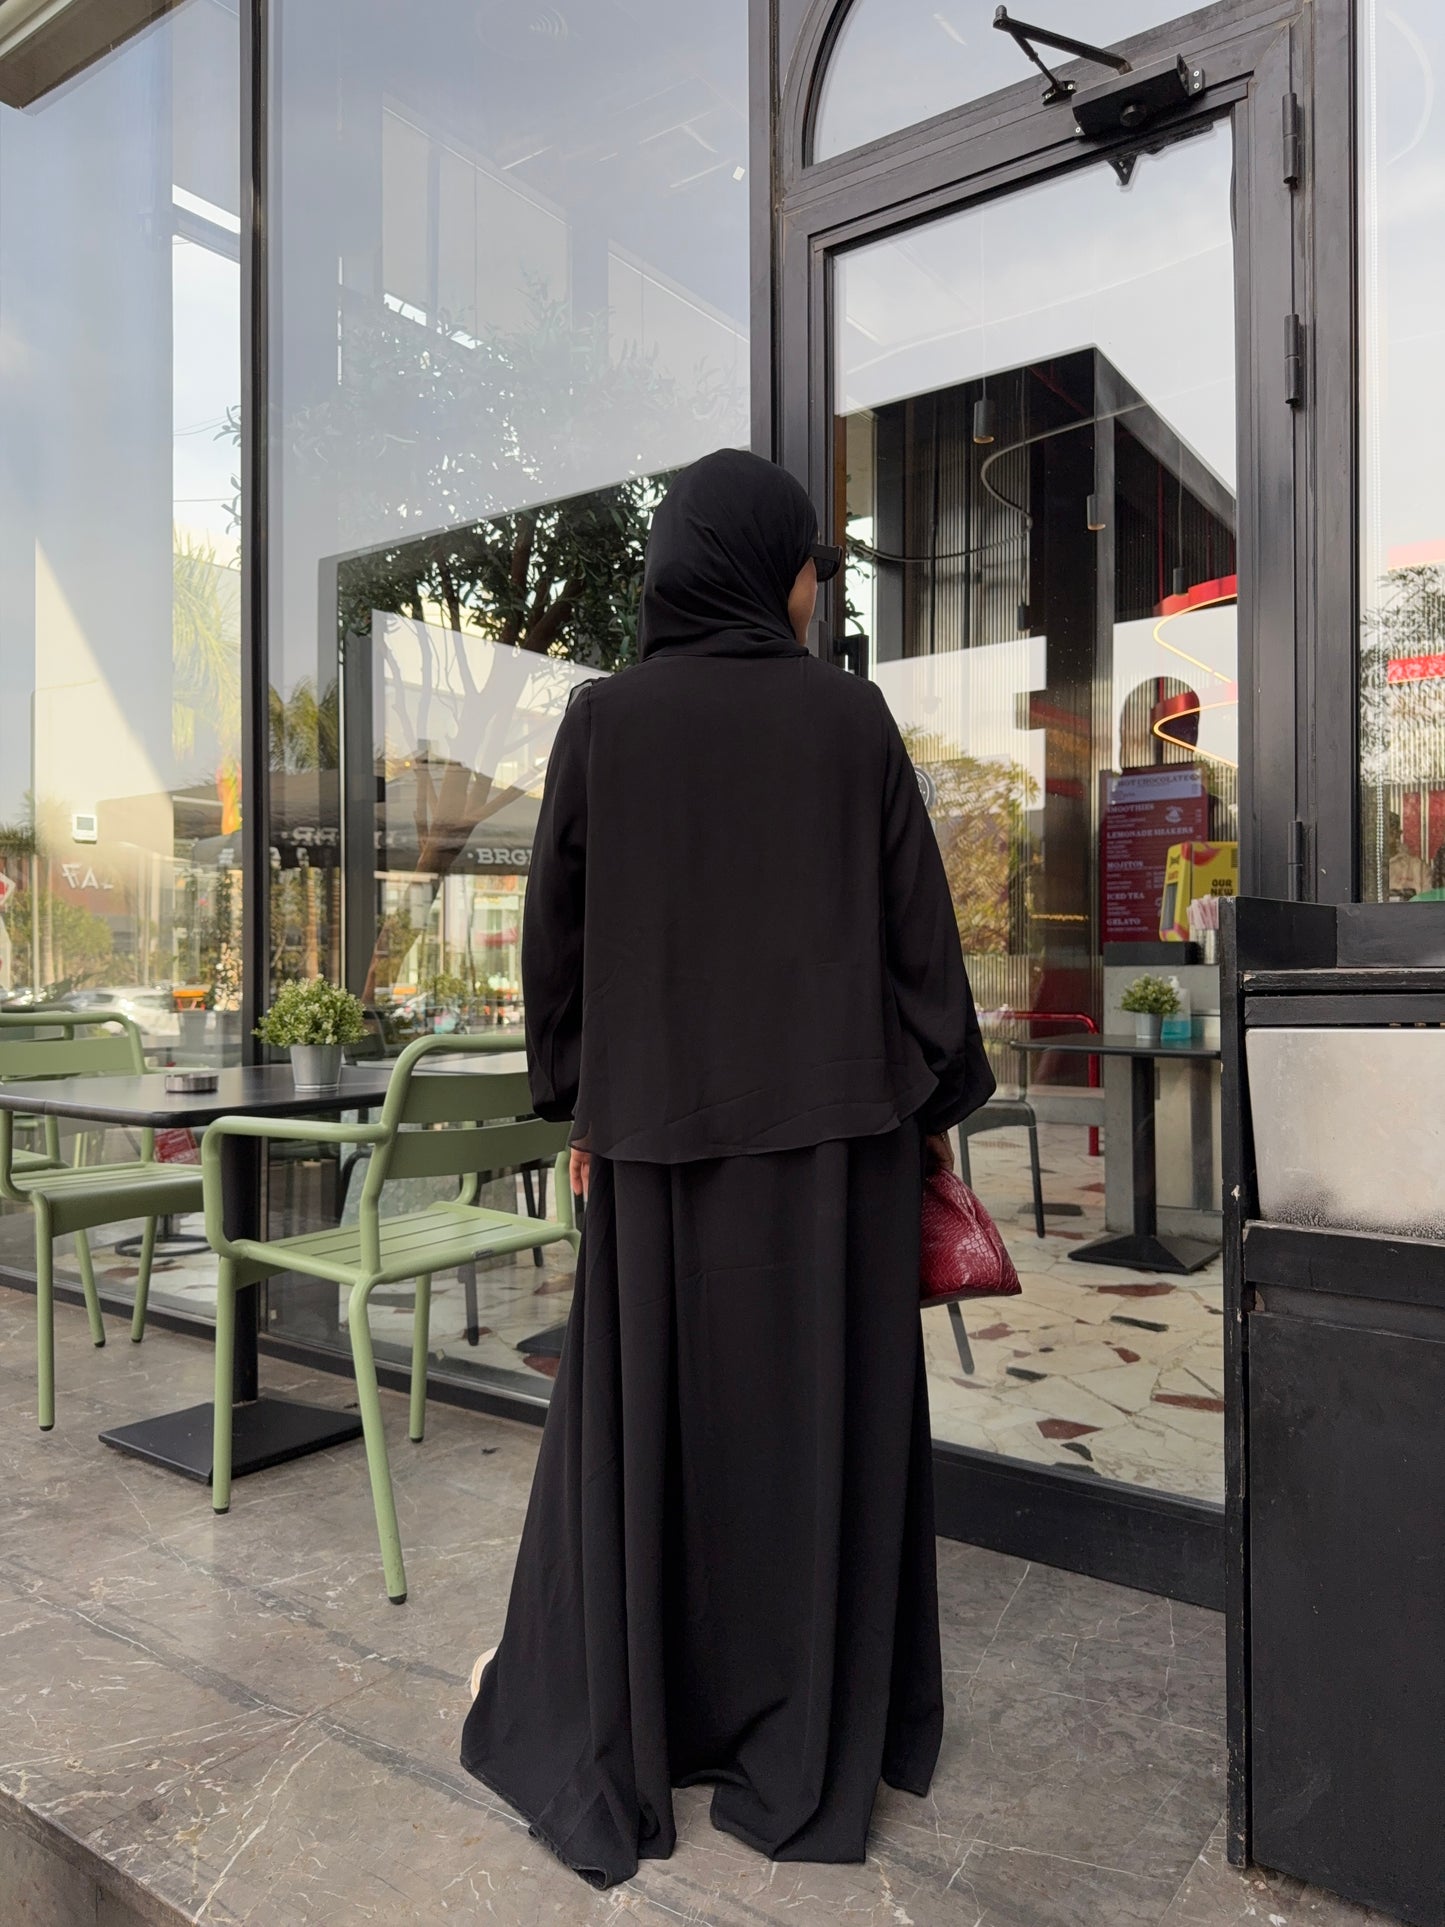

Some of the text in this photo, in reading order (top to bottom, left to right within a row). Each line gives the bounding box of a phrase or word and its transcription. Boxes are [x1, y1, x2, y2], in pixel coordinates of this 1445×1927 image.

[1107, 826, 1193, 839] LEMONADE SHAKERS
[1107, 861, 1144, 870] MOJITOS
[1211, 878, 1233, 887] OUR
[1107, 892, 1145, 901] ICED TEA
[1210, 888, 1233, 896] NEW
[1106, 917, 1141, 926] GELATO
